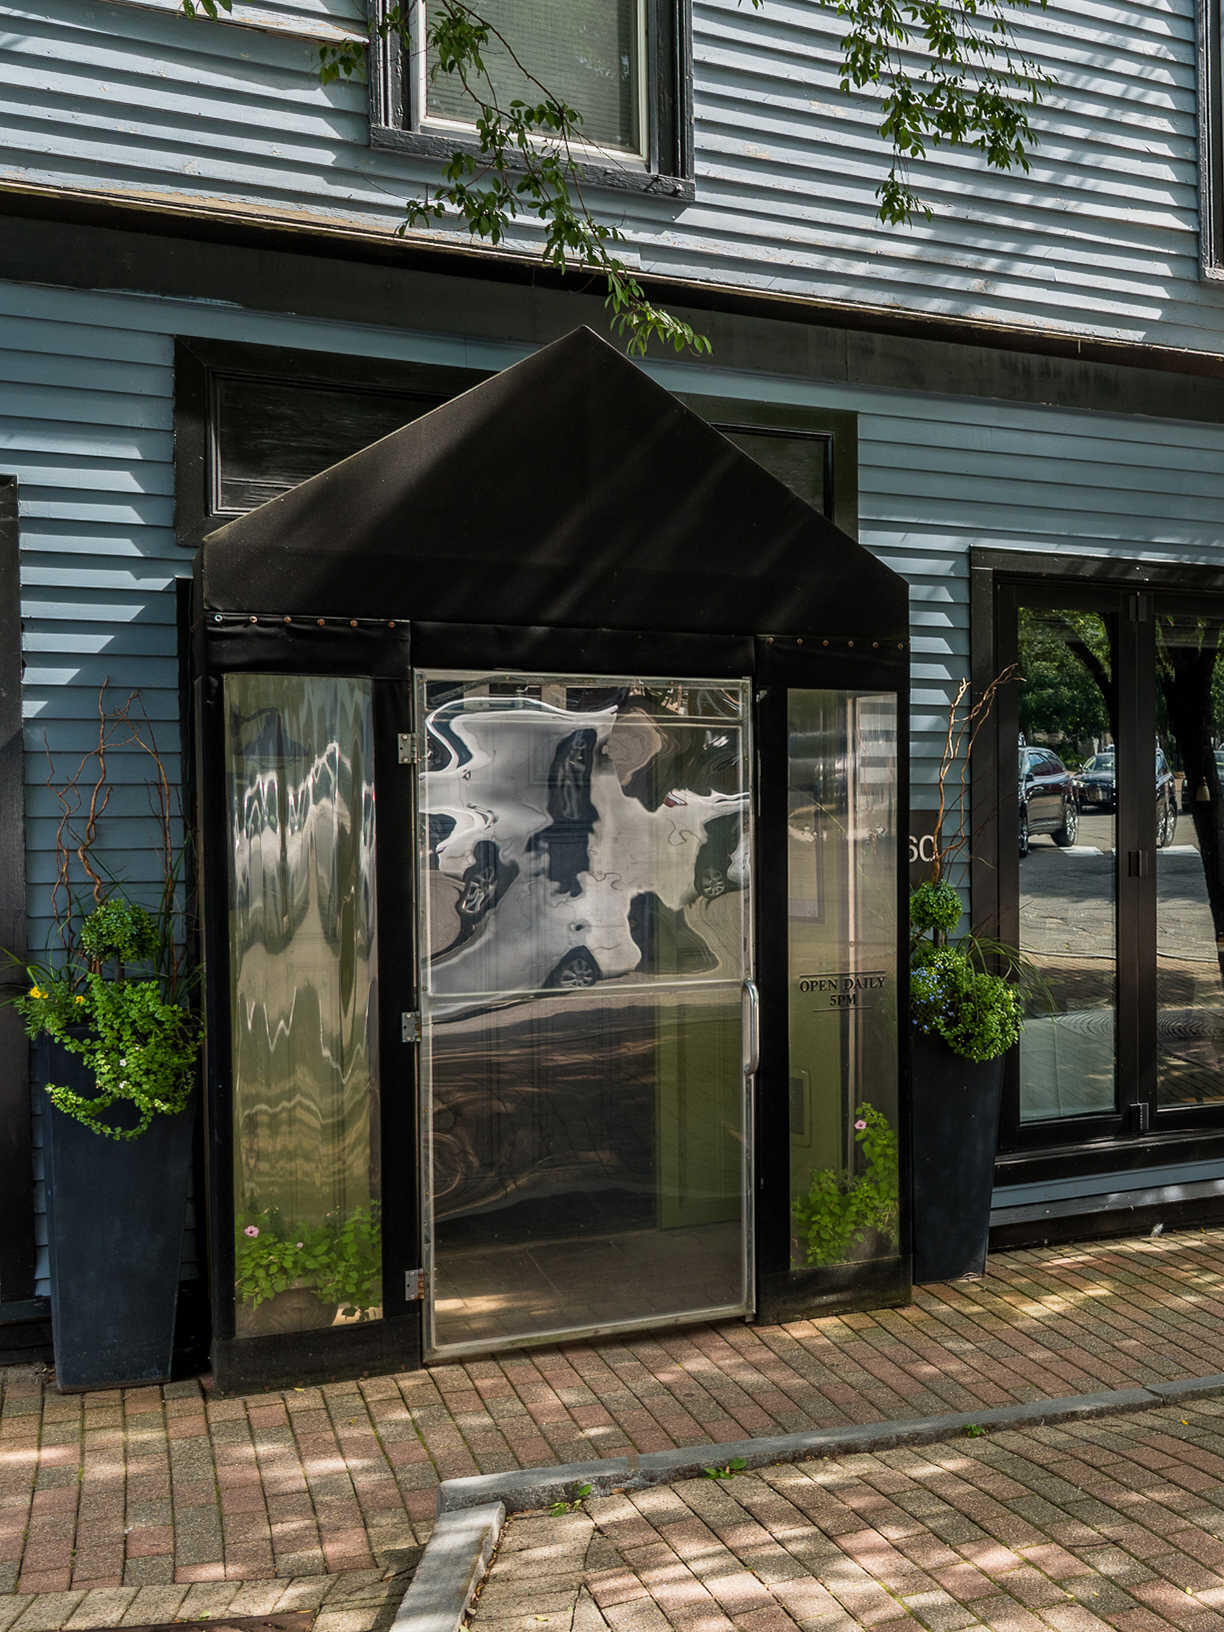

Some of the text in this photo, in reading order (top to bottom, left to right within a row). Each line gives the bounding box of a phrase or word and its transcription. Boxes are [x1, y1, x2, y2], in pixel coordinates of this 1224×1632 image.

[800, 976, 887, 993] OPEN DAILY
[829, 994, 856, 1007] 5PM
